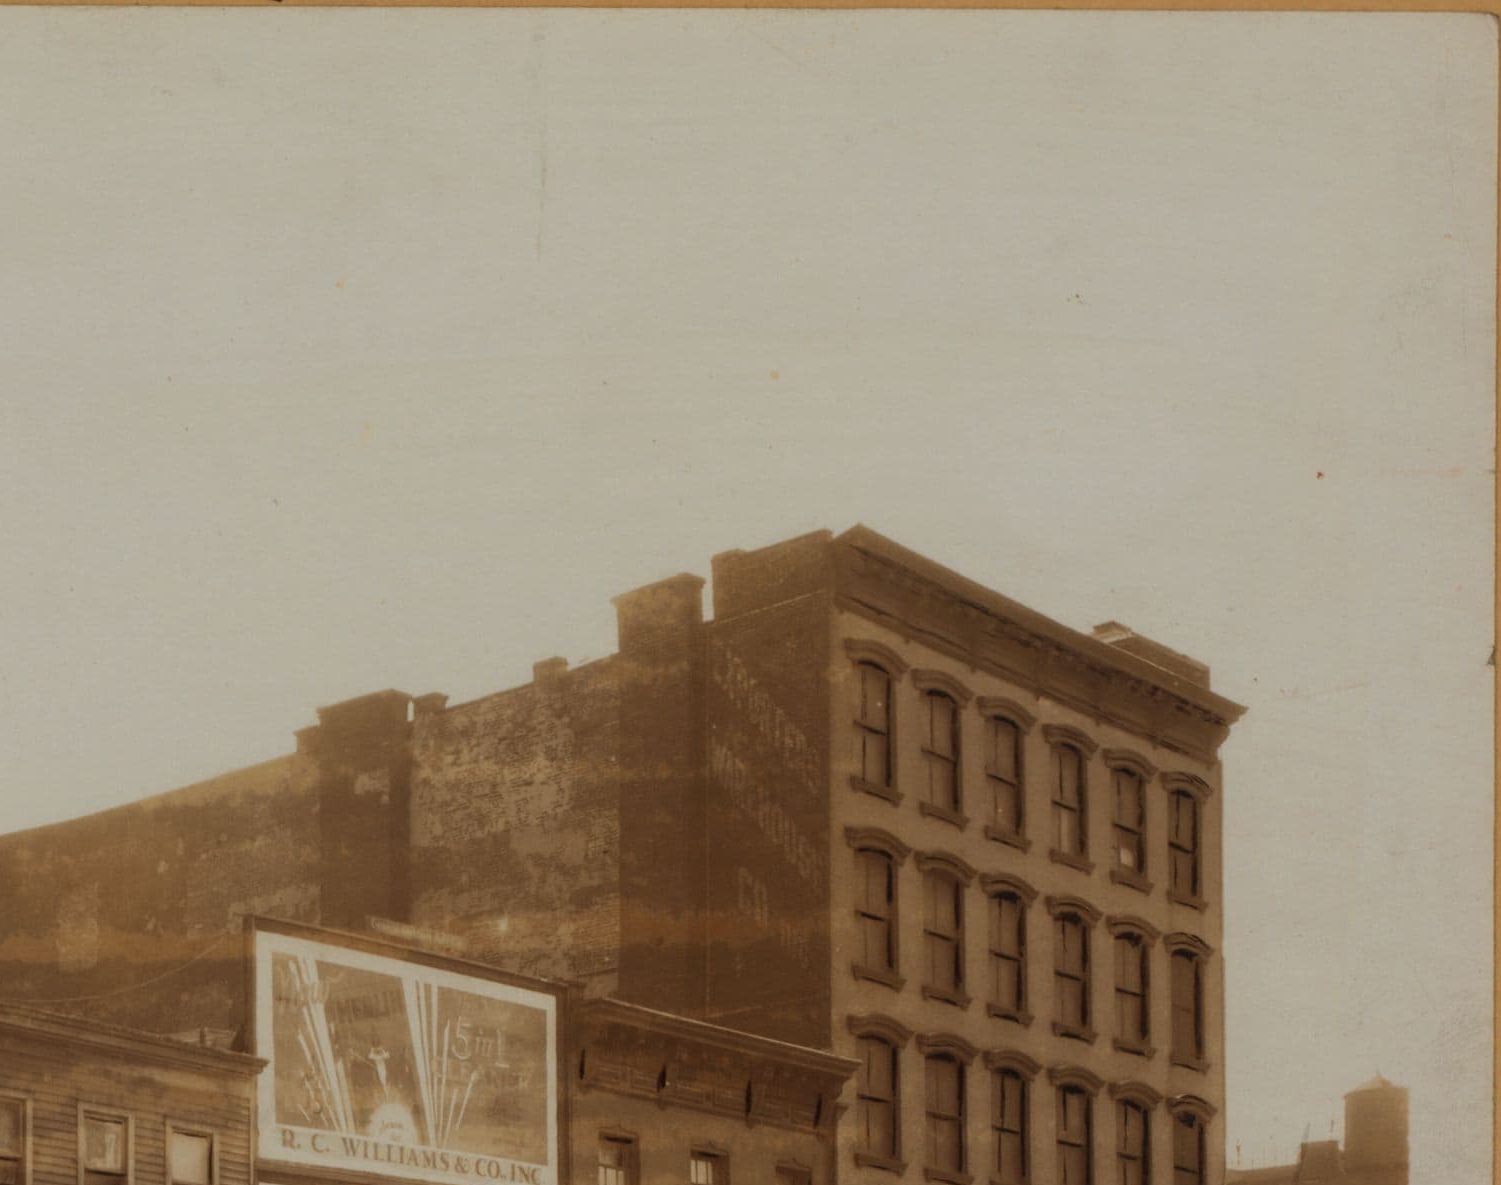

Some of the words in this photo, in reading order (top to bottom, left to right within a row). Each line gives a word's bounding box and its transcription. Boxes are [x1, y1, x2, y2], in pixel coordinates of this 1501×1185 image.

[281, 1128, 301, 1150] R.
[311, 1134, 330, 1153] C.
[341, 1137, 450, 1172] WILLIAMS
[454, 1155, 469, 1174] &
